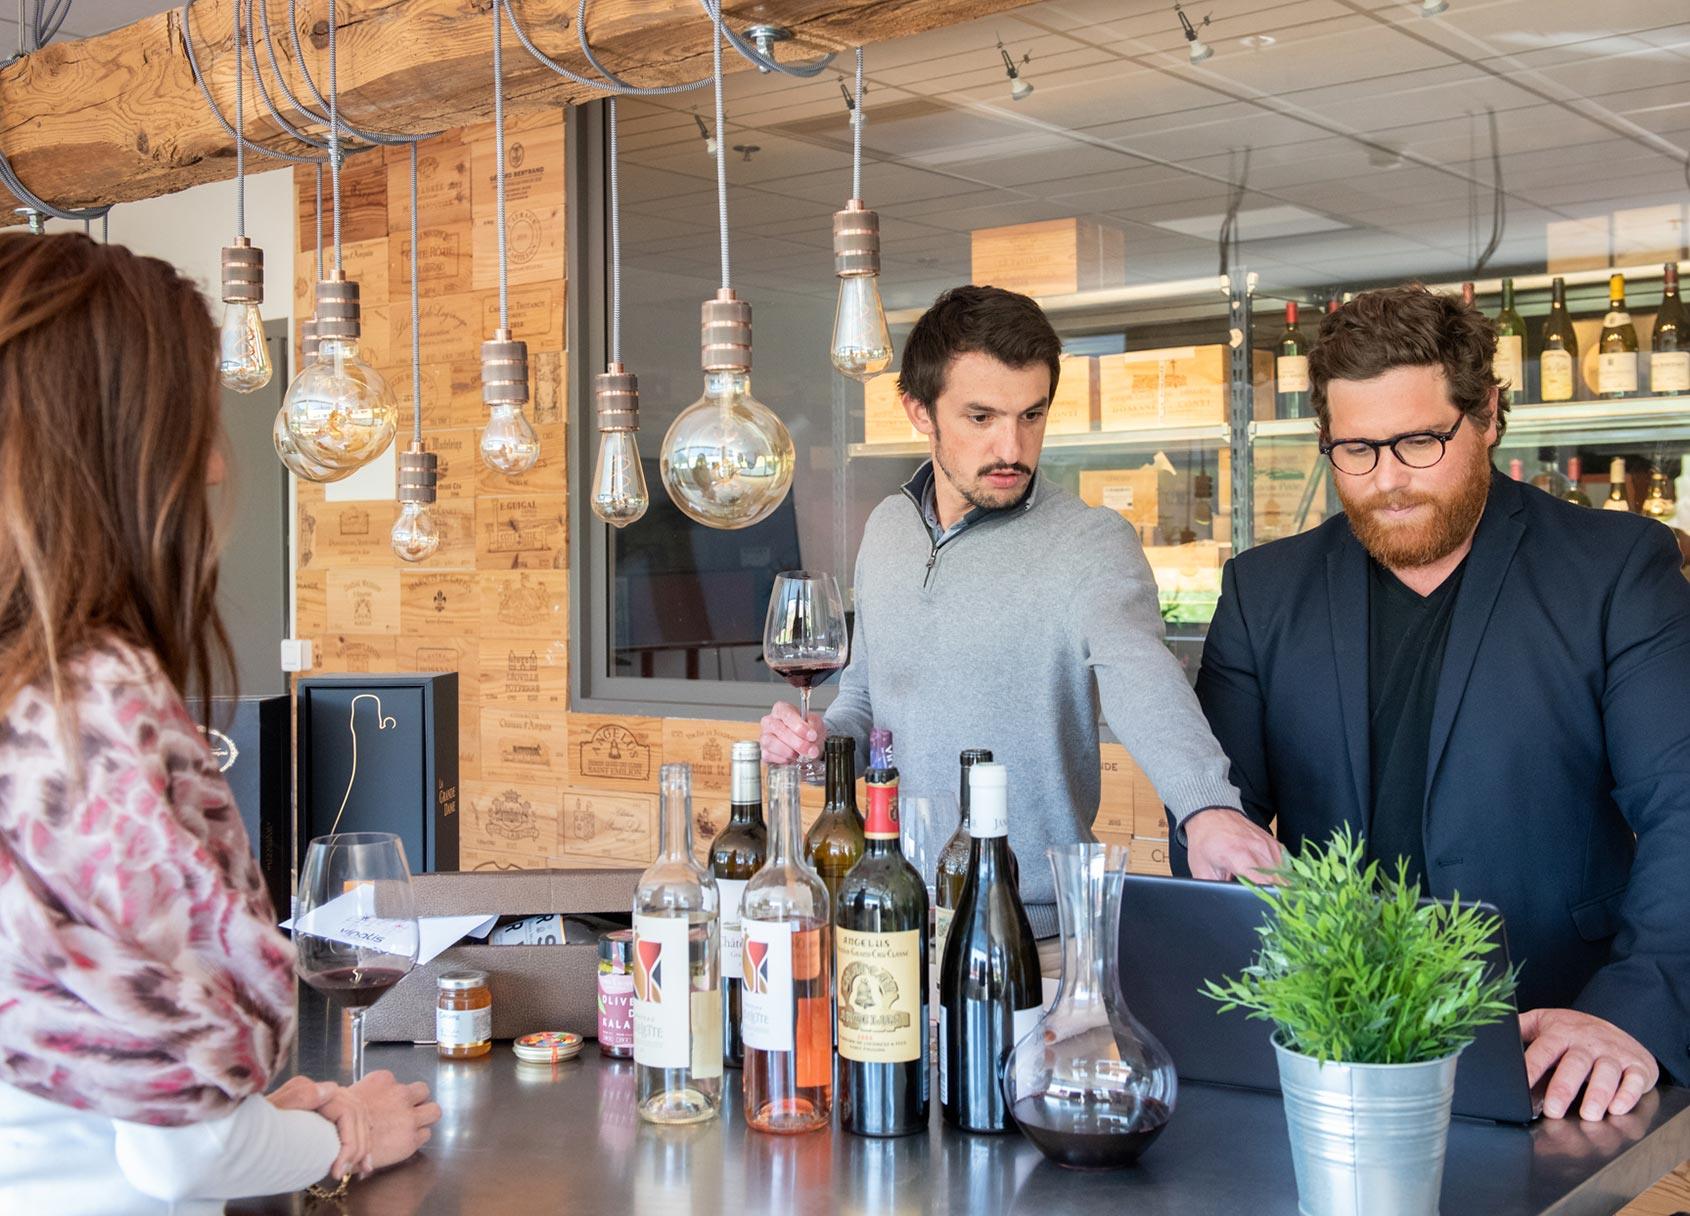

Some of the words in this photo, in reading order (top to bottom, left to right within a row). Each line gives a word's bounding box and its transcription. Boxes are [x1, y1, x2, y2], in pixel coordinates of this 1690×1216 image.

[592, 727, 639, 759] ANGELUS
[628, 1008, 635, 1018] D
[602, 1018, 632, 1029] KALA
